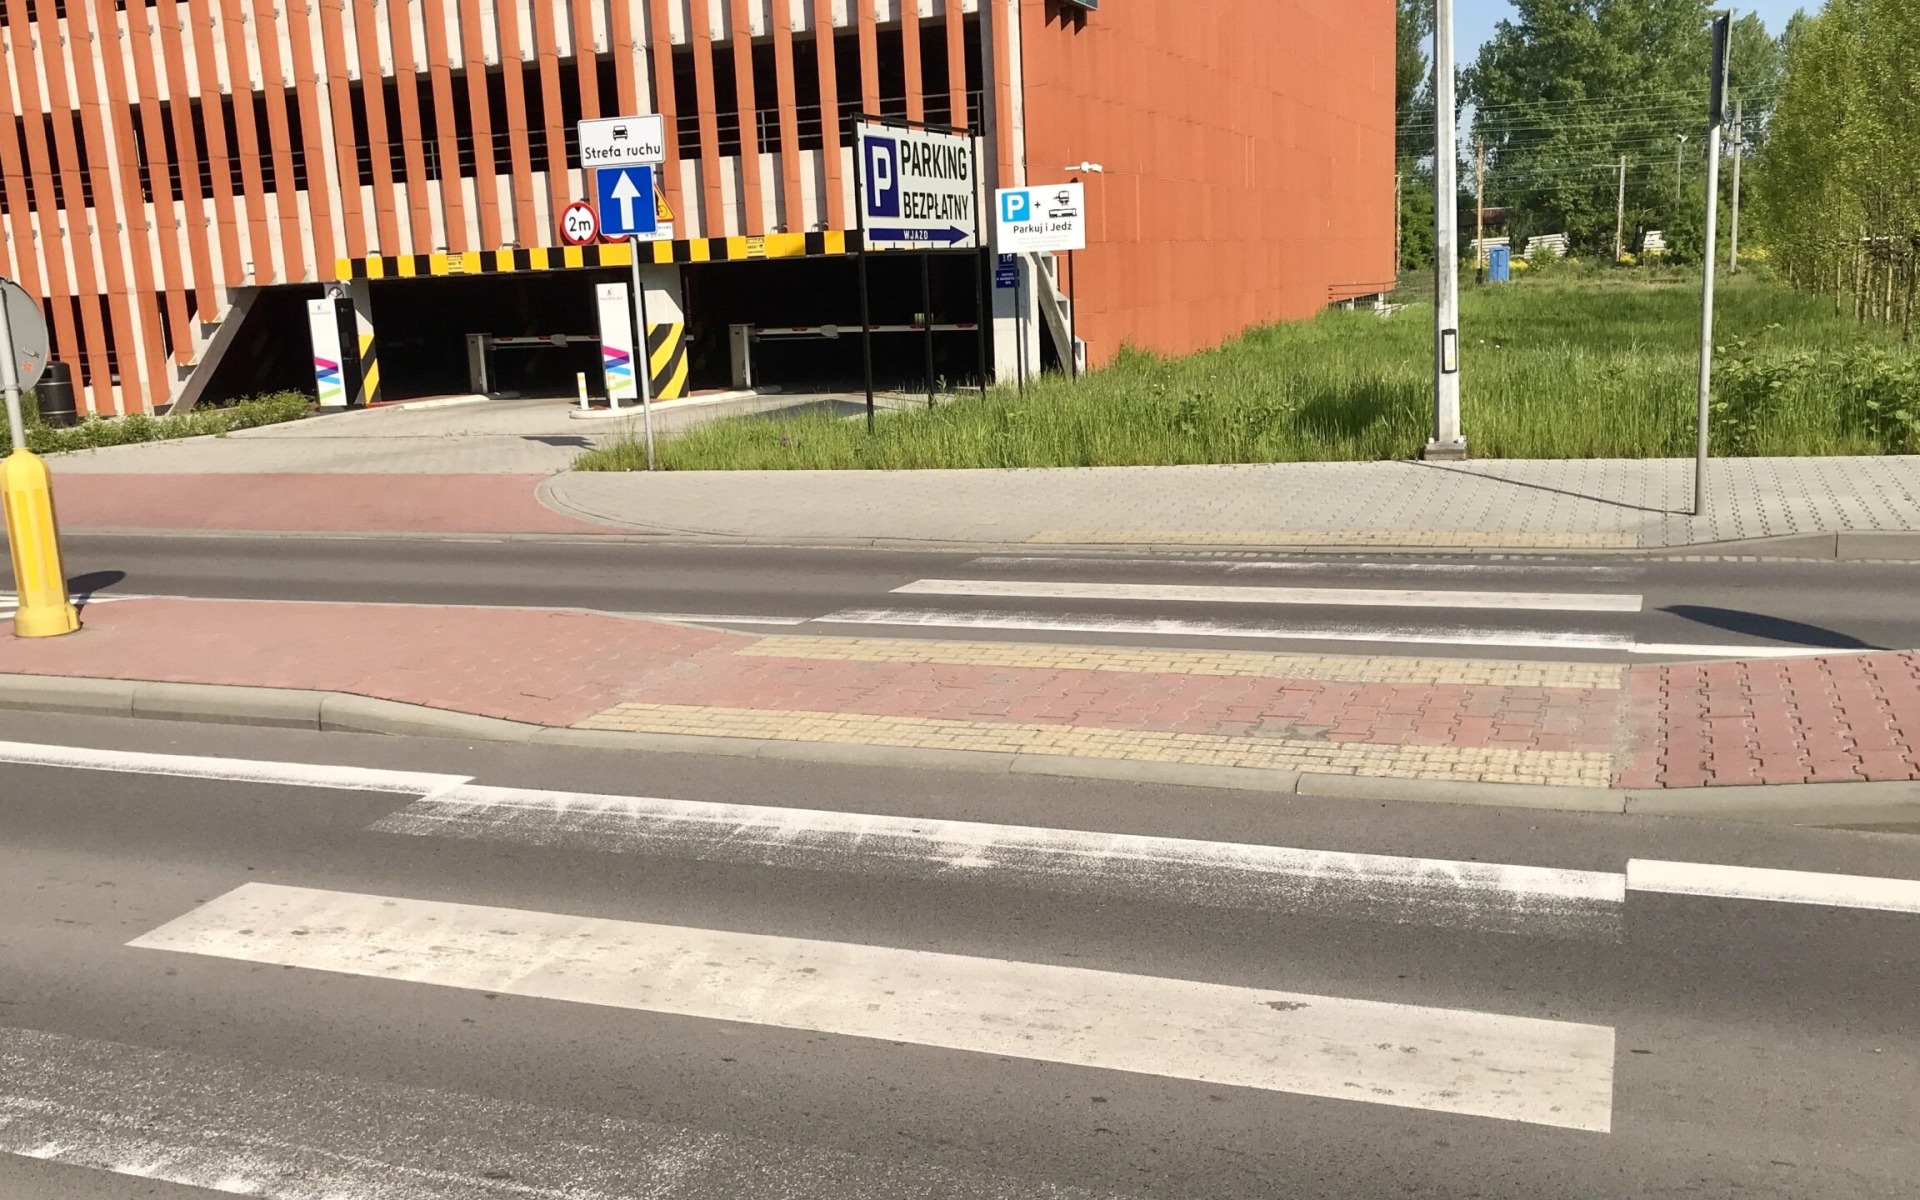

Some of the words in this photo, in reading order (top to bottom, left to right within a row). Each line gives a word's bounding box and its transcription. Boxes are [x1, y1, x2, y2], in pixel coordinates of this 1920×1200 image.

[585, 146, 621, 160] Strefa
[626, 143, 661, 156] ruchu
[900, 139, 968, 181] PARKING
[872, 145, 892, 207] P
[903, 191, 969, 220] BEZPŁATNY
[1007, 194, 1025, 220] P
[568, 216, 592, 232] 2m
[1013, 223, 1043, 235] Parkuj
[1045, 222, 1049, 232] i
